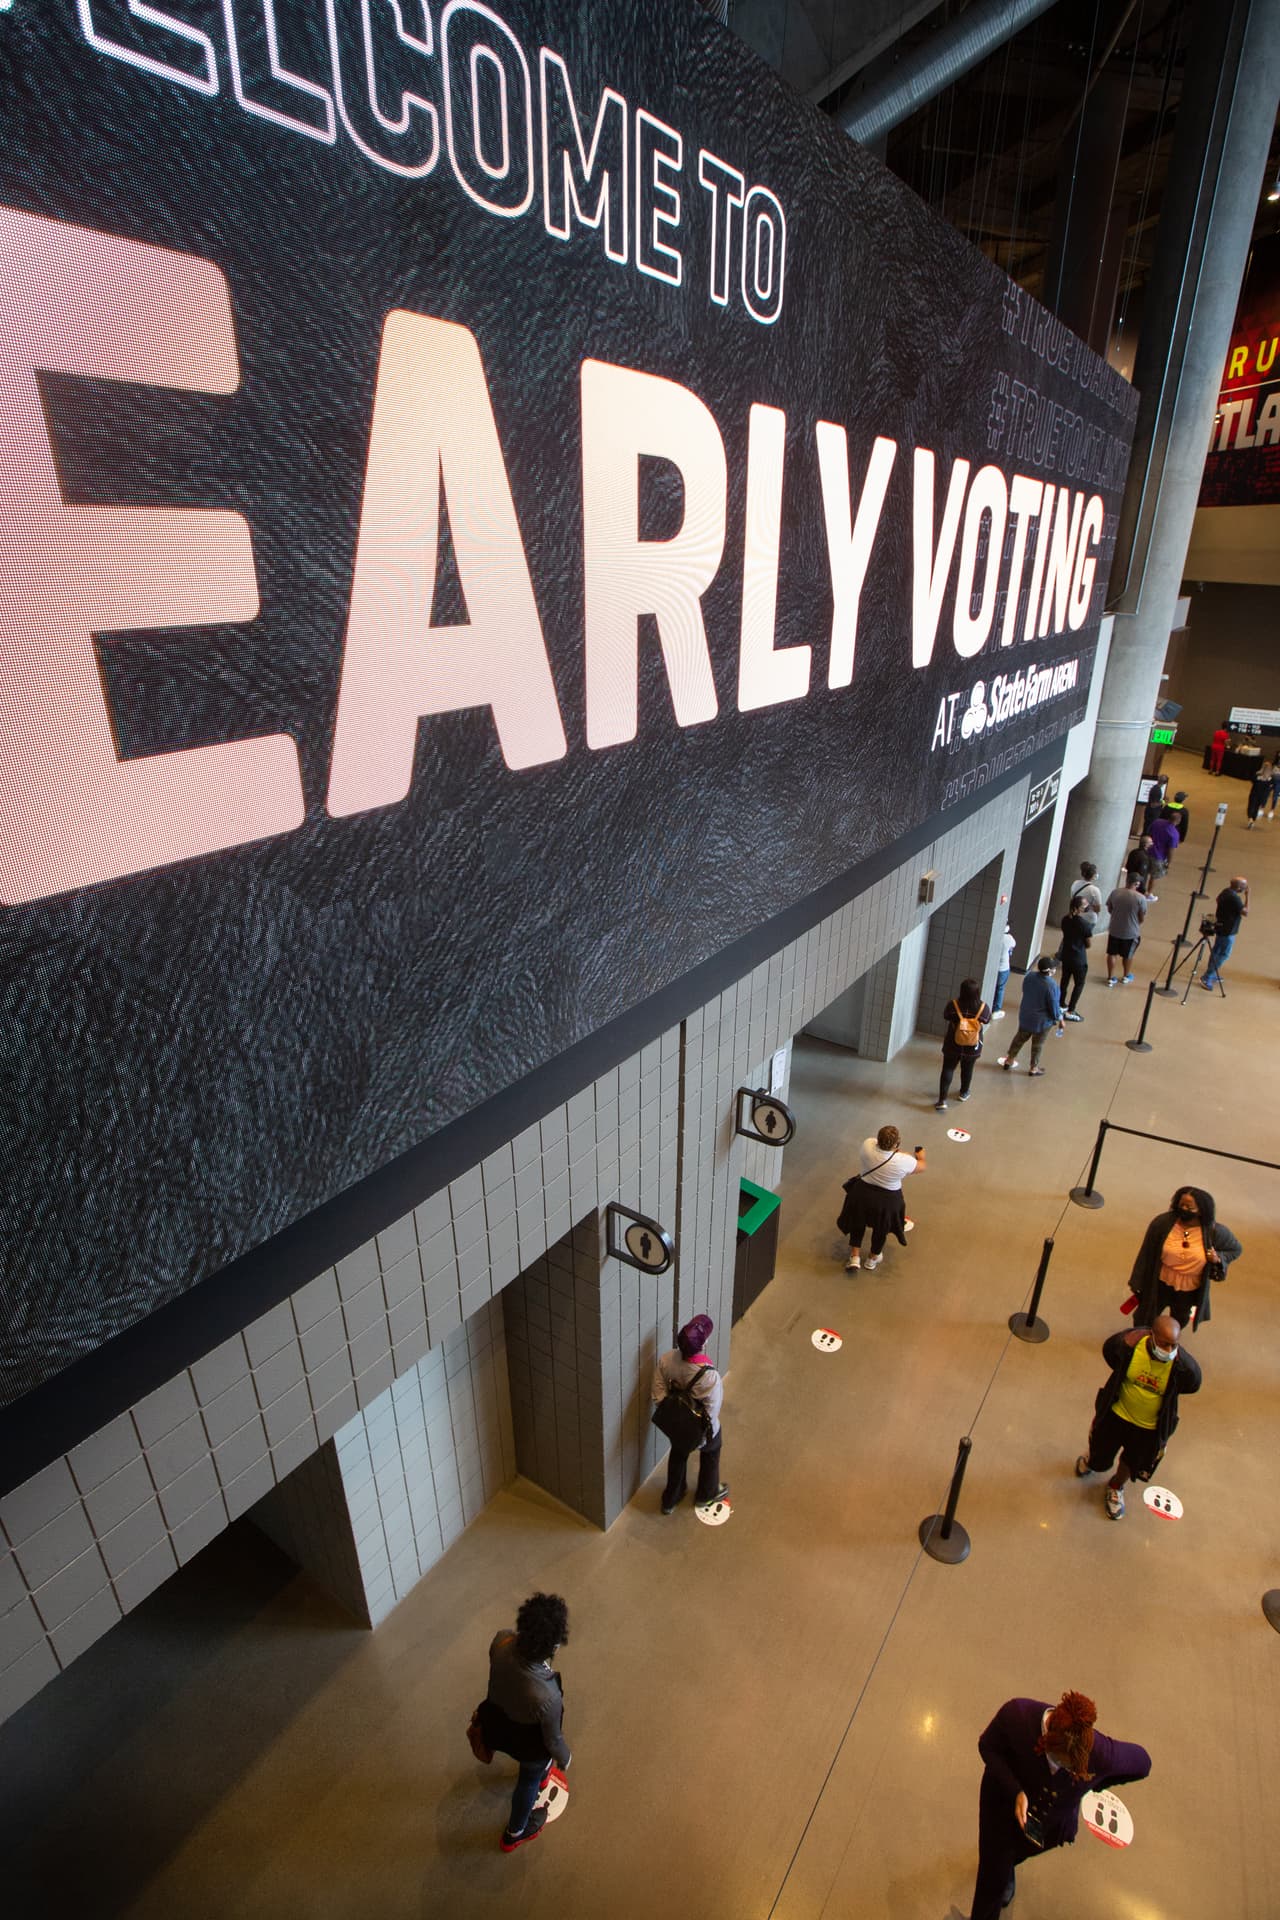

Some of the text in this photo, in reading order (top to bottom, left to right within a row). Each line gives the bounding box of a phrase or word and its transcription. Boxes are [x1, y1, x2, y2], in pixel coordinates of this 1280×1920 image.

[699, 149, 786, 324] TO
[0, 207, 1104, 907] EARLY VOTING
[931, 691, 961, 752] AT
[1049, 658, 1079, 699] ARENA
